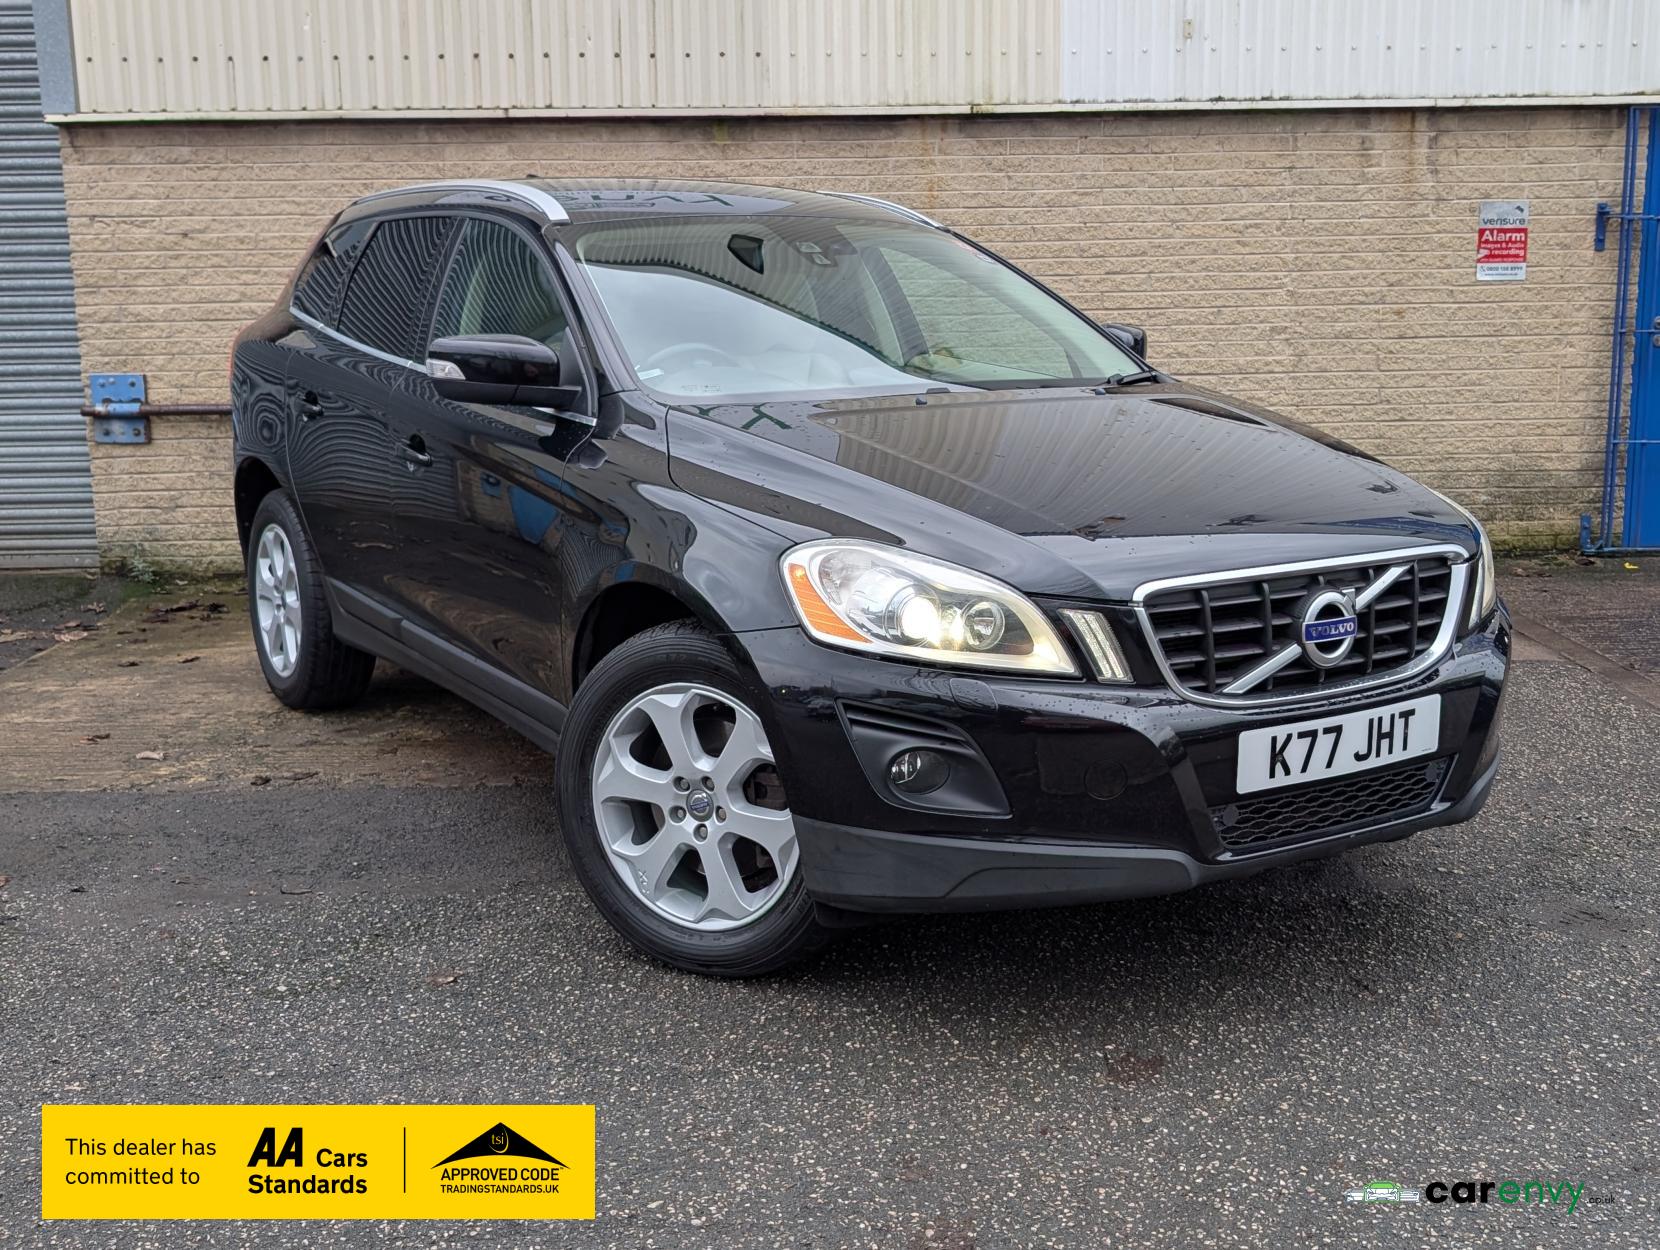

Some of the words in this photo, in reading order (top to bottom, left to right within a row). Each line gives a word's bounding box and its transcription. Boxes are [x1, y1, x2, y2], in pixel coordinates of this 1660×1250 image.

[1482, 217, 1526, 226] verisure
[1481, 229, 1526, 242] Alarm
[1309, 622, 1355, 637] VOLVO
[1269, 724, 1344, 780] K77
[1353, 707, 1416, 763] JHT
